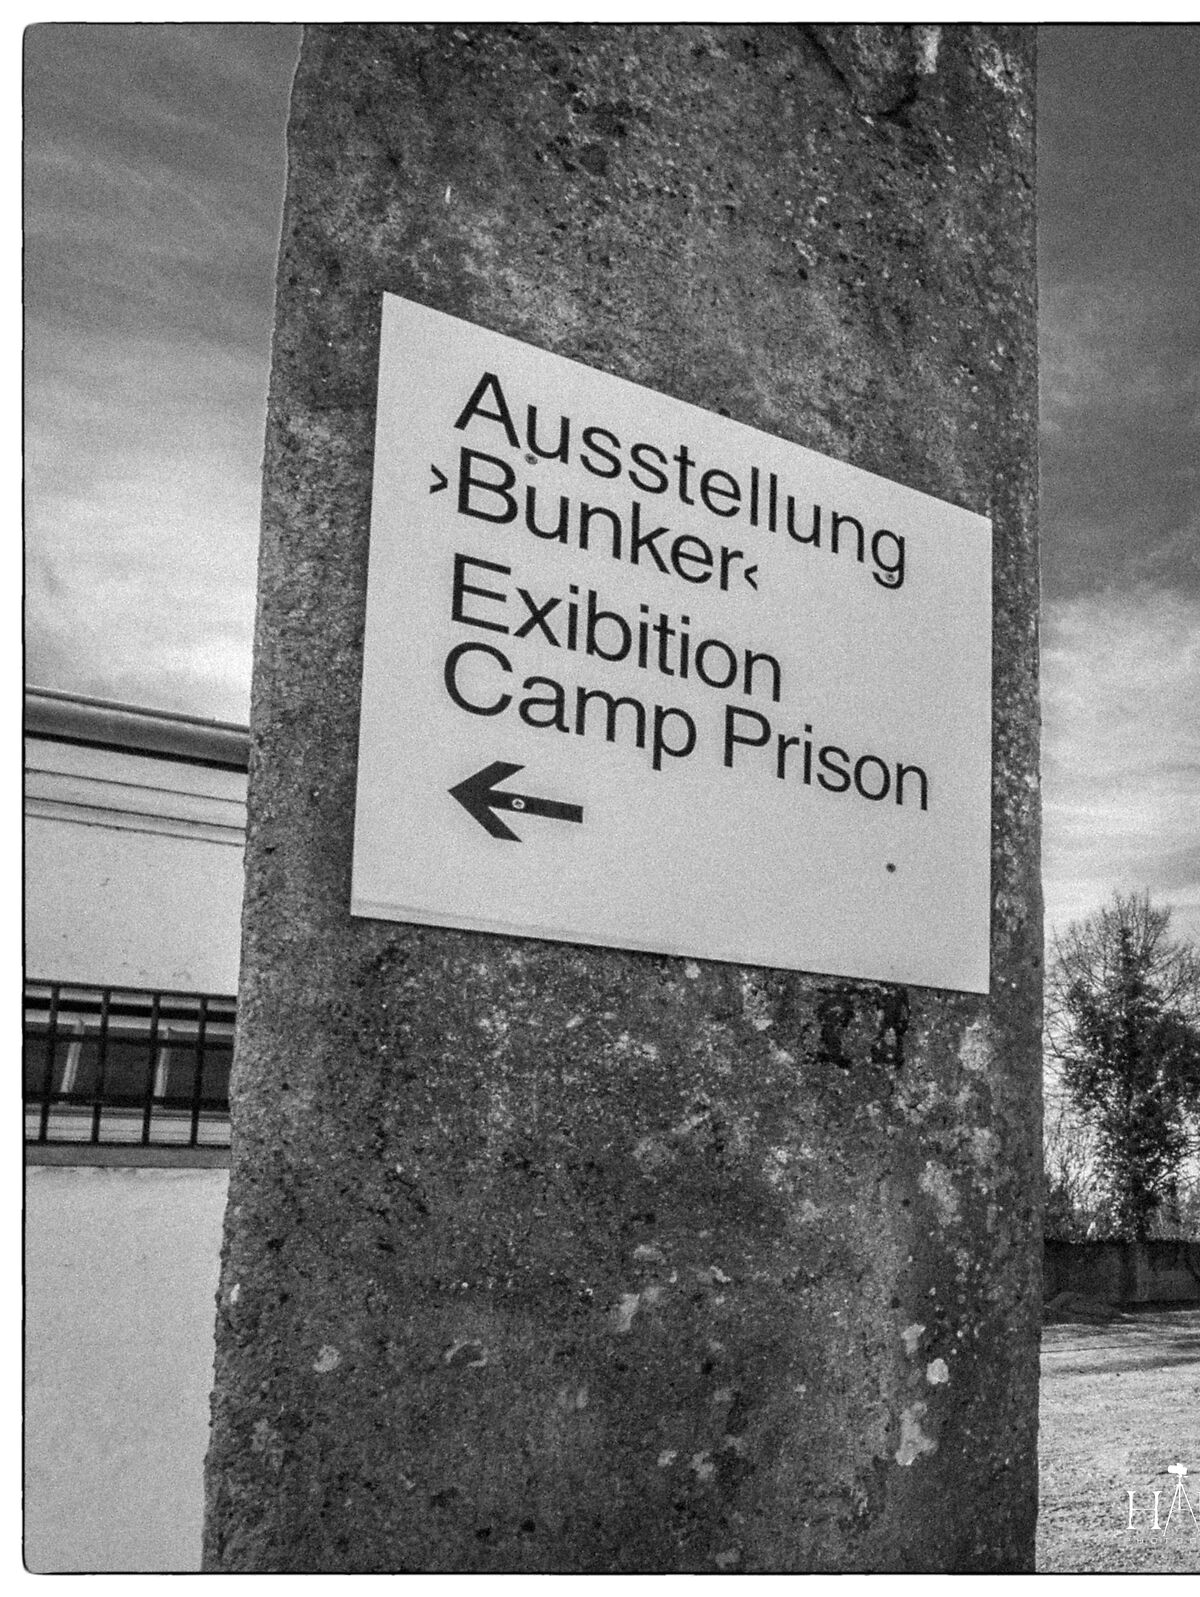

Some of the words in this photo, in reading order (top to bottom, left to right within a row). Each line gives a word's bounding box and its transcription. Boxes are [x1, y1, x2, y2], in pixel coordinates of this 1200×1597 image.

[454, 371, 907, 590] Ausstellung
[451, 552, 783, 703] Exibition
[444, 641, 698, 771] Camp
[723, 704, 928, 811] Prison
